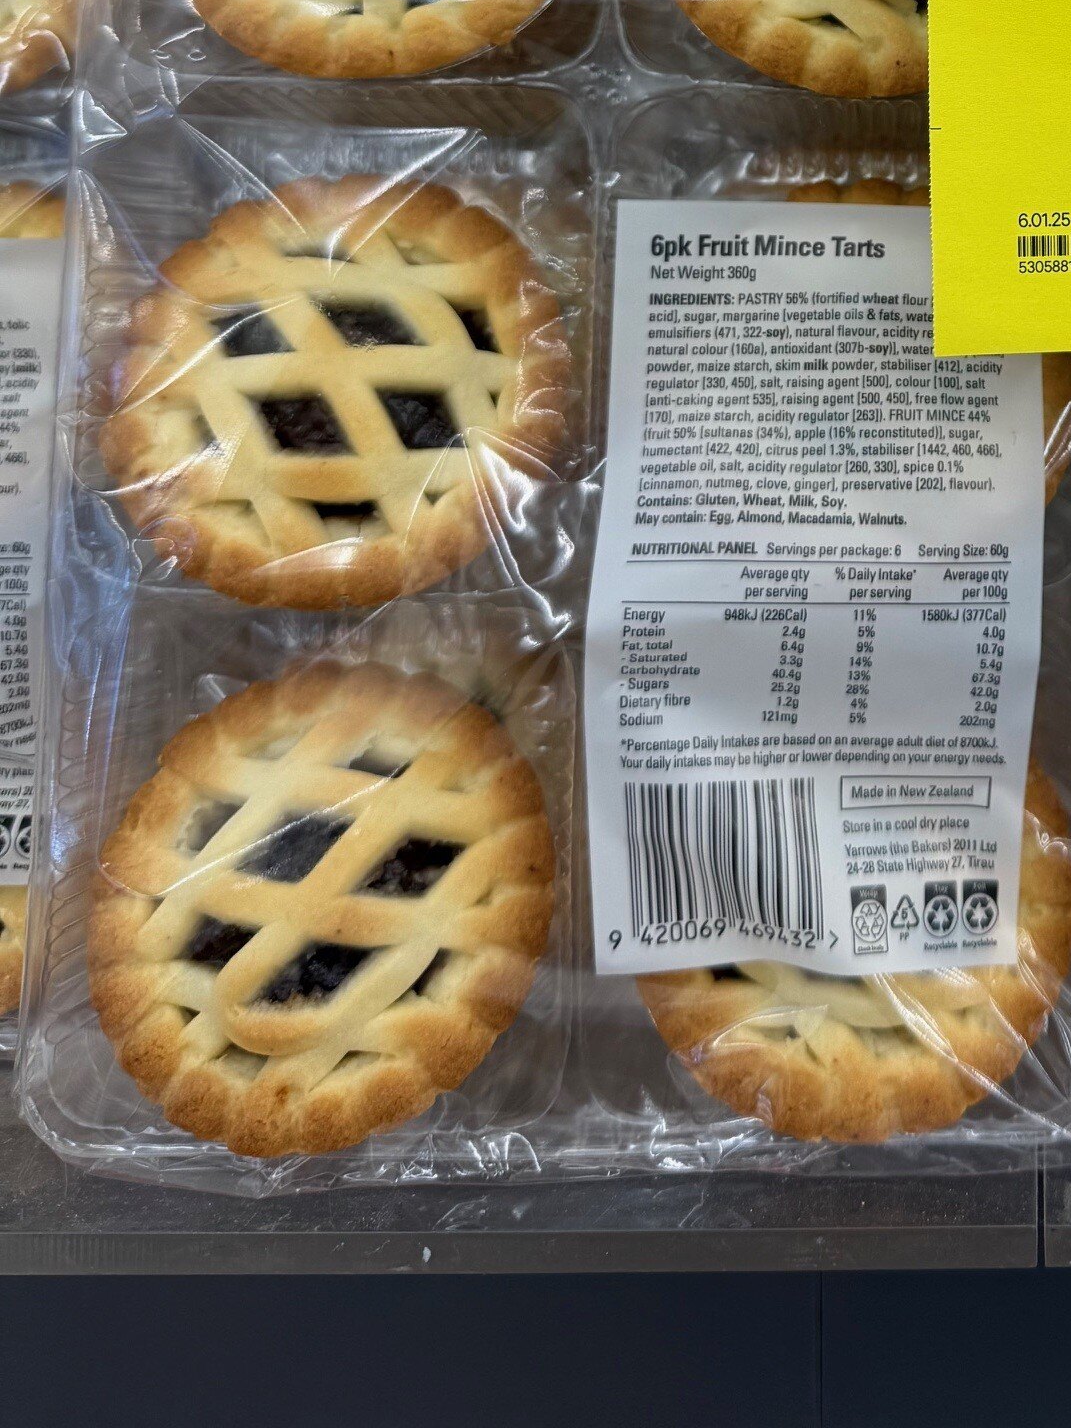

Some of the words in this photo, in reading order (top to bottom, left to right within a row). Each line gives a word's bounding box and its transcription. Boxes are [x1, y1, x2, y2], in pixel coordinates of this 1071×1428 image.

[651, 234, 692, 263] 6pk
[698, 234, 749, 257] Fruit
[754, 235, 825, 257] Mince
[831, 236, 885, 258] Tarts
[650, 265, 675, 279] Net
[677, 265, 725, 282] Weight
[727, 265, 756, 282] 360g
[649, 293, 735, 305] INGREDIENTS:
[738, 292, 783, 305] PASTRY
[786, 291, 809, 305] 56%
[811, 292, 860, 305] (fortified
[863, 292, 899, 305] wheat
[902, 293, 929, 306] flour
[646, 360, 694, 375] powder,
[697, 359, 730, 372] maize
[733, 359, 772, 373] starch,
[775, 359, 801, 371] skim
[804, 358, 828, 371] milk
[831, 358, 877, 373] powder,
[881, 358, 932, 371] stabiliser
[934, 359, 963, 374] [412],
[966, 361, 1003, 375] acidity
[646, 377, 699, 392] regulator
[702, 376, 728, 390] [330,
[731, 375, 757, 390] 450],
[760, 376, 783, 389] salt,
[786, 375, 824, 390] raising
[827, 377, 859, 390] agent
[862, 374, 892, 389] [500],
[895, 375, 931, 388] colour
[934, 375, 963, 390] [100],
[965, 377, 986, 389] salt
[637, 494, 692, 508] Contains:
[695, 493, 739, 507] Gluten,
[743, 493, 785, 508] Wheat,
[789, 494, 818, 509] Milk,
[821, 495, 847, 510] Soy.
[635, 512, 660, 527] May
[661, 510, 707, 524] contain:
[709, 510, 734, 525] Egg,
[737, 510, 785, 525] Almond,
[788, 511, 855, 526] Macadamia,
[859, 512, 907, 525] Walnuts.
[631, 542, 715, 555] NUTRITIONAL
[717, 541, 758, 555] PANEL
[766, 542, 816, 558] Servings
[819, 546, 838, 558] per
[840, 543, 892, 559] package:
[894, 544, 901, 557] 6
[918, 544, 960, 560] Serving
[963, 544, 988, 557] Size:
[990, 543, 1009, 559] 60g
[619, 713, 663, 728] Sodium
[762, 710, 798, 725] 121mg
[849, 711, 866, 724] 5%
[959, 715, 996, 730] 202mg
[851, 785, 884, 800] Made
[886, 785, 897, 798] in
[899, 784, 927, 798] New
[928, 784, 974, 798] Zealand
[842, 820, 871, 834] Store
[873, 818, 883, 833] in
[885, 821, 892, 832] a
[894, 816, 917, 831] cool
[919, 816, 937, 831] dry
[939, 816, 970, 831] place
[844, 844, 888, 859] Yarrows
[889, 841, 909, 856] (the
[911, 837, 951, 854] Bakers)
[953, 838, 977, 852] 2011
[980, 840, 997, 855] Ltd
[609, 929, 622, 950] 9
[640, 918, 726, 947] 420069
[739, 921, 817, 950] 469432
